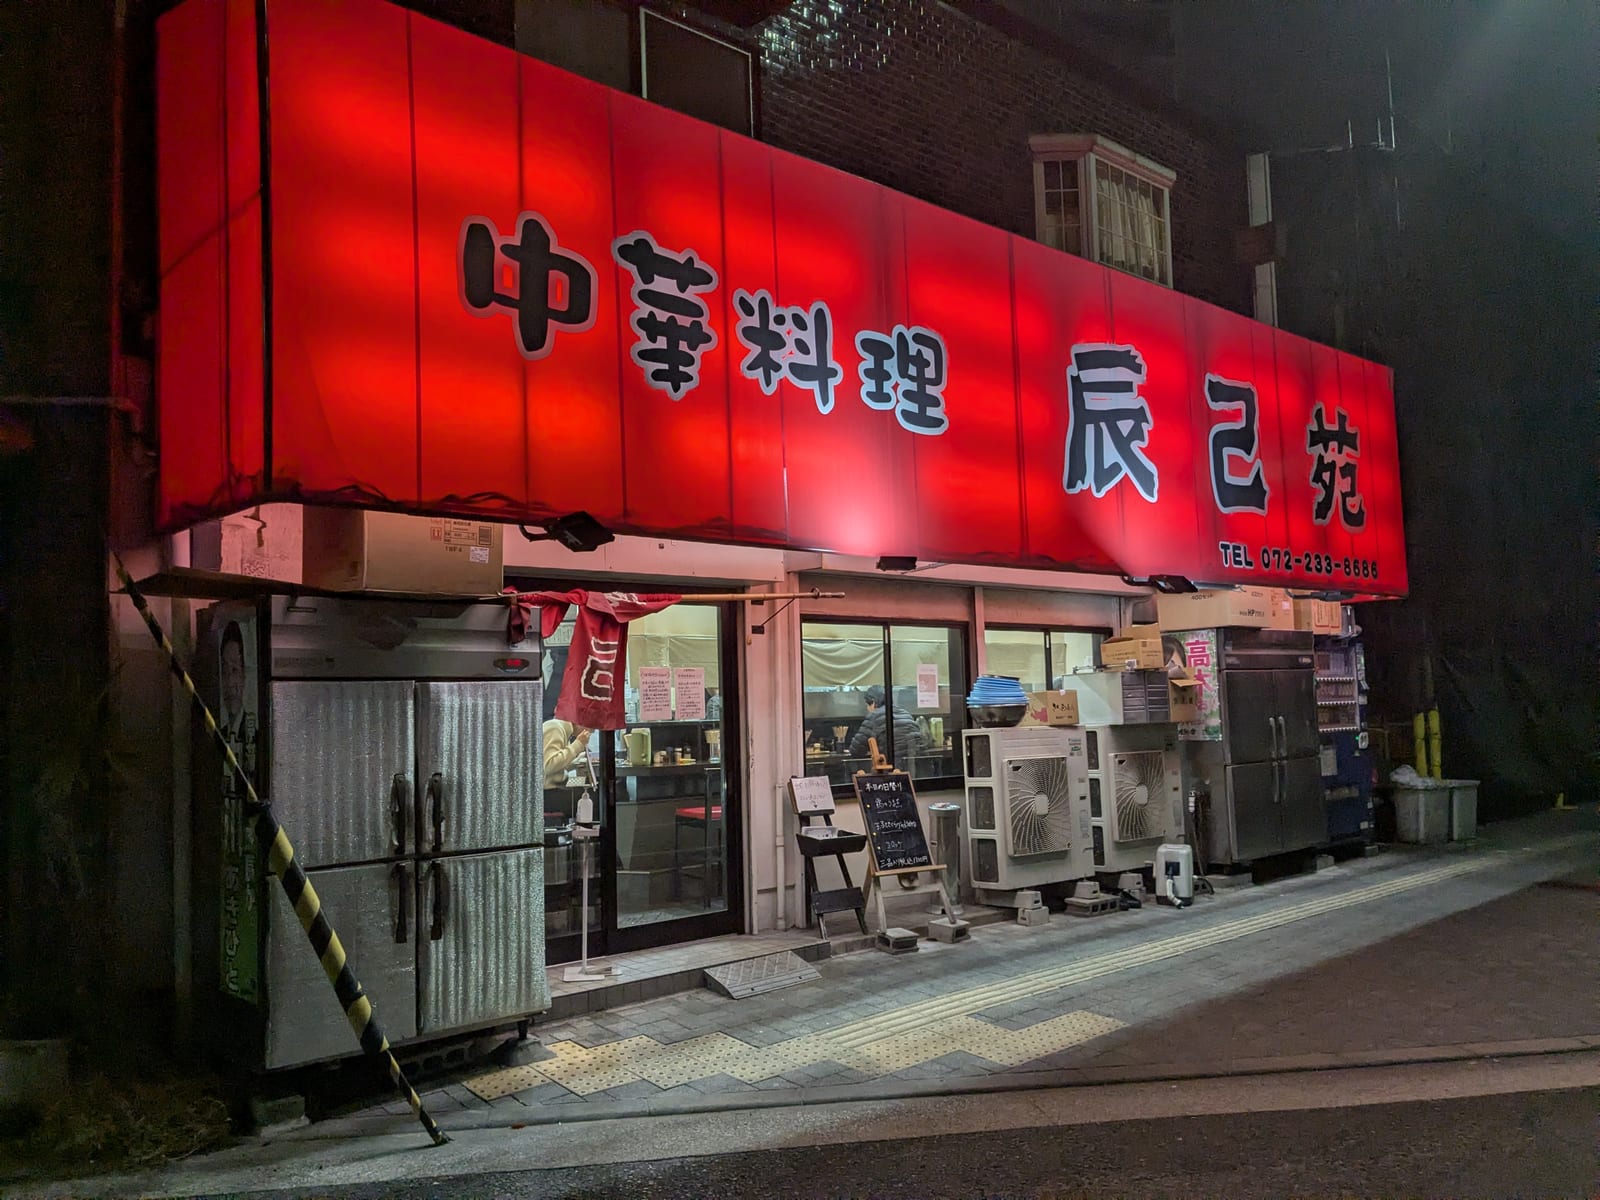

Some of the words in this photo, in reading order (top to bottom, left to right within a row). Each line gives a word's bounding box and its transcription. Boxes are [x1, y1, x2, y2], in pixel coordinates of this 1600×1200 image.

[458, 212, 947, 434] 中華料理
[1219, 541, 1254, 569] TEL
[1261, 547, 1378, 580] 072-233-8686
